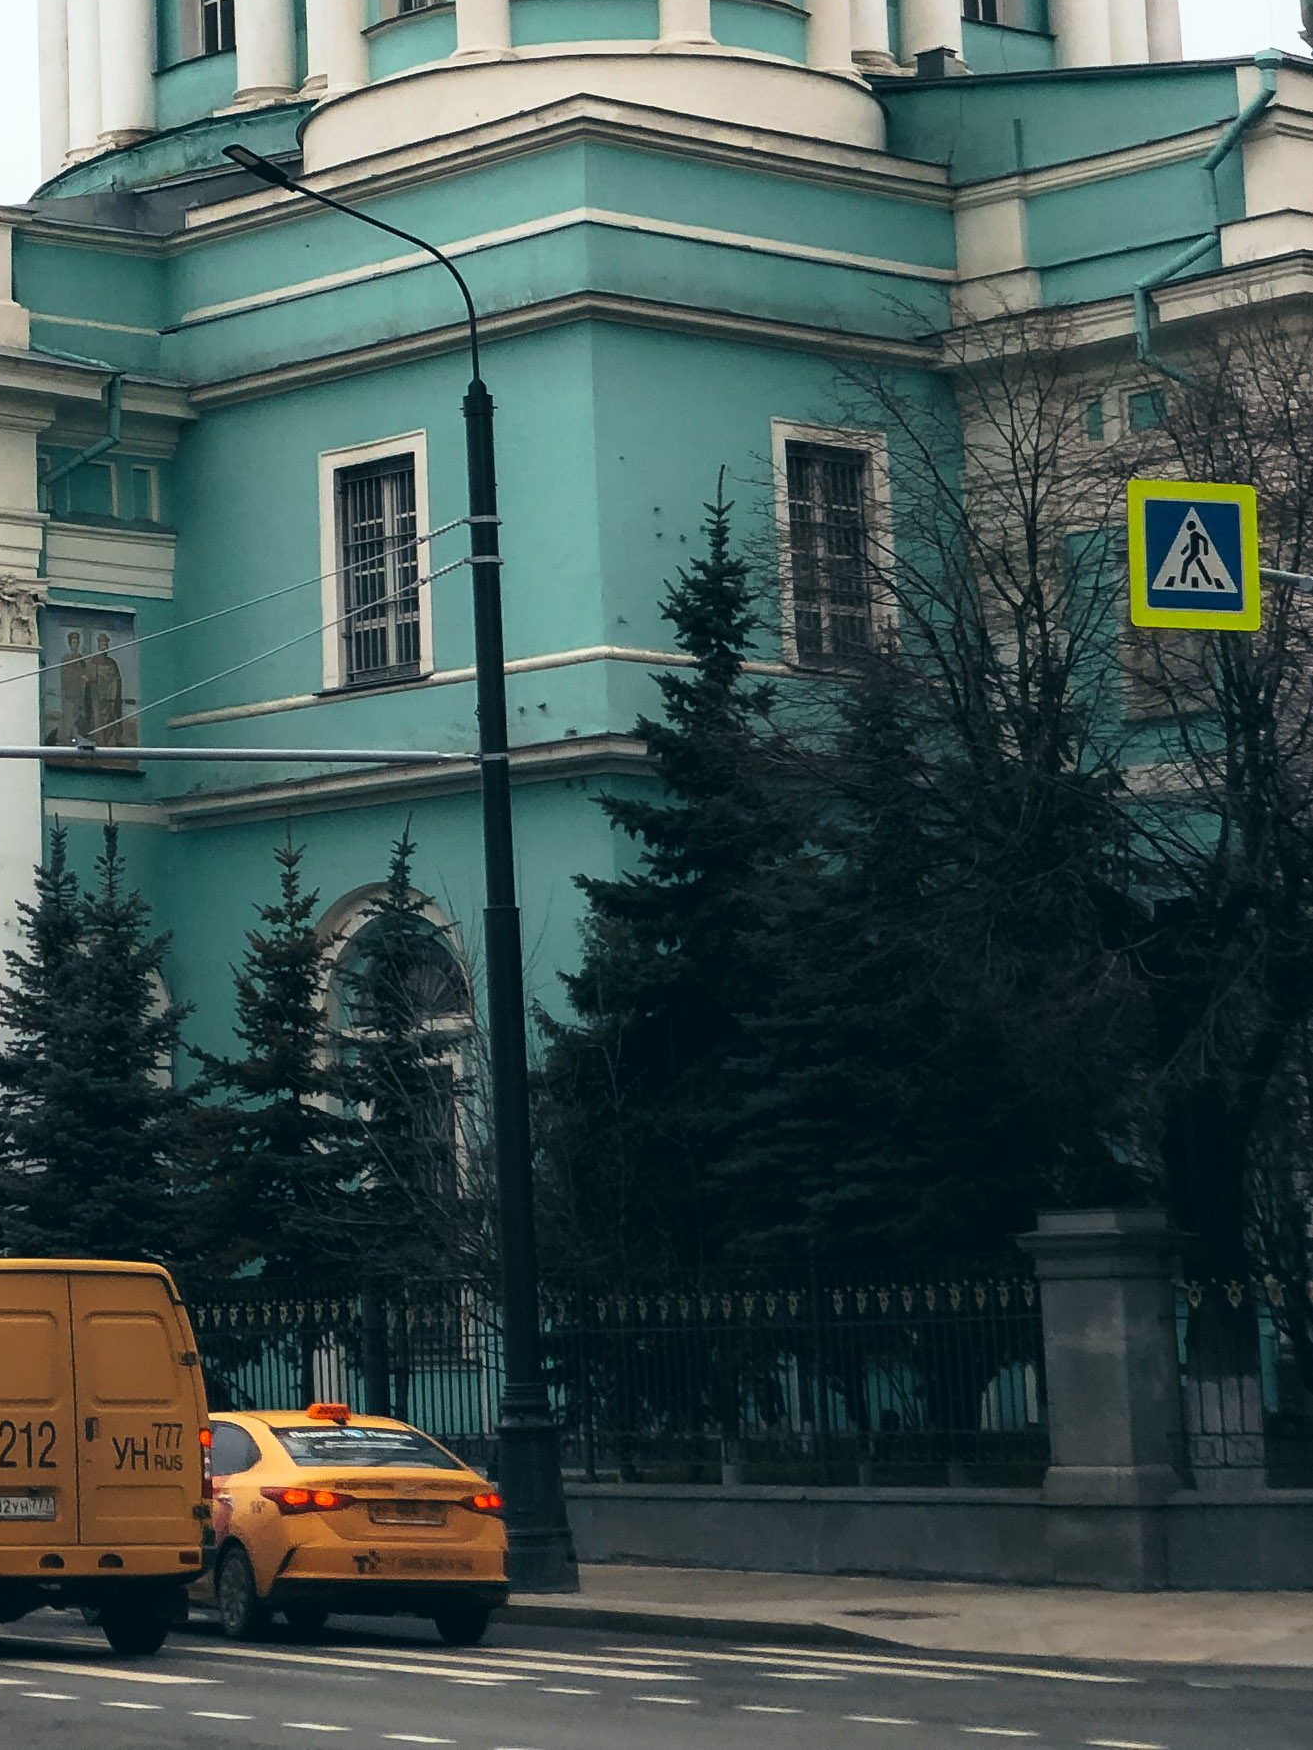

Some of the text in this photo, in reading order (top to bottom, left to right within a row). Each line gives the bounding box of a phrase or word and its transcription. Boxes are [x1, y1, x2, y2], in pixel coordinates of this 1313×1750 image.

[112, 1437, 149, 1471] УН
[152, 1423, 183, 1449] 777
[154, 1454, 183, 1471] RUS
